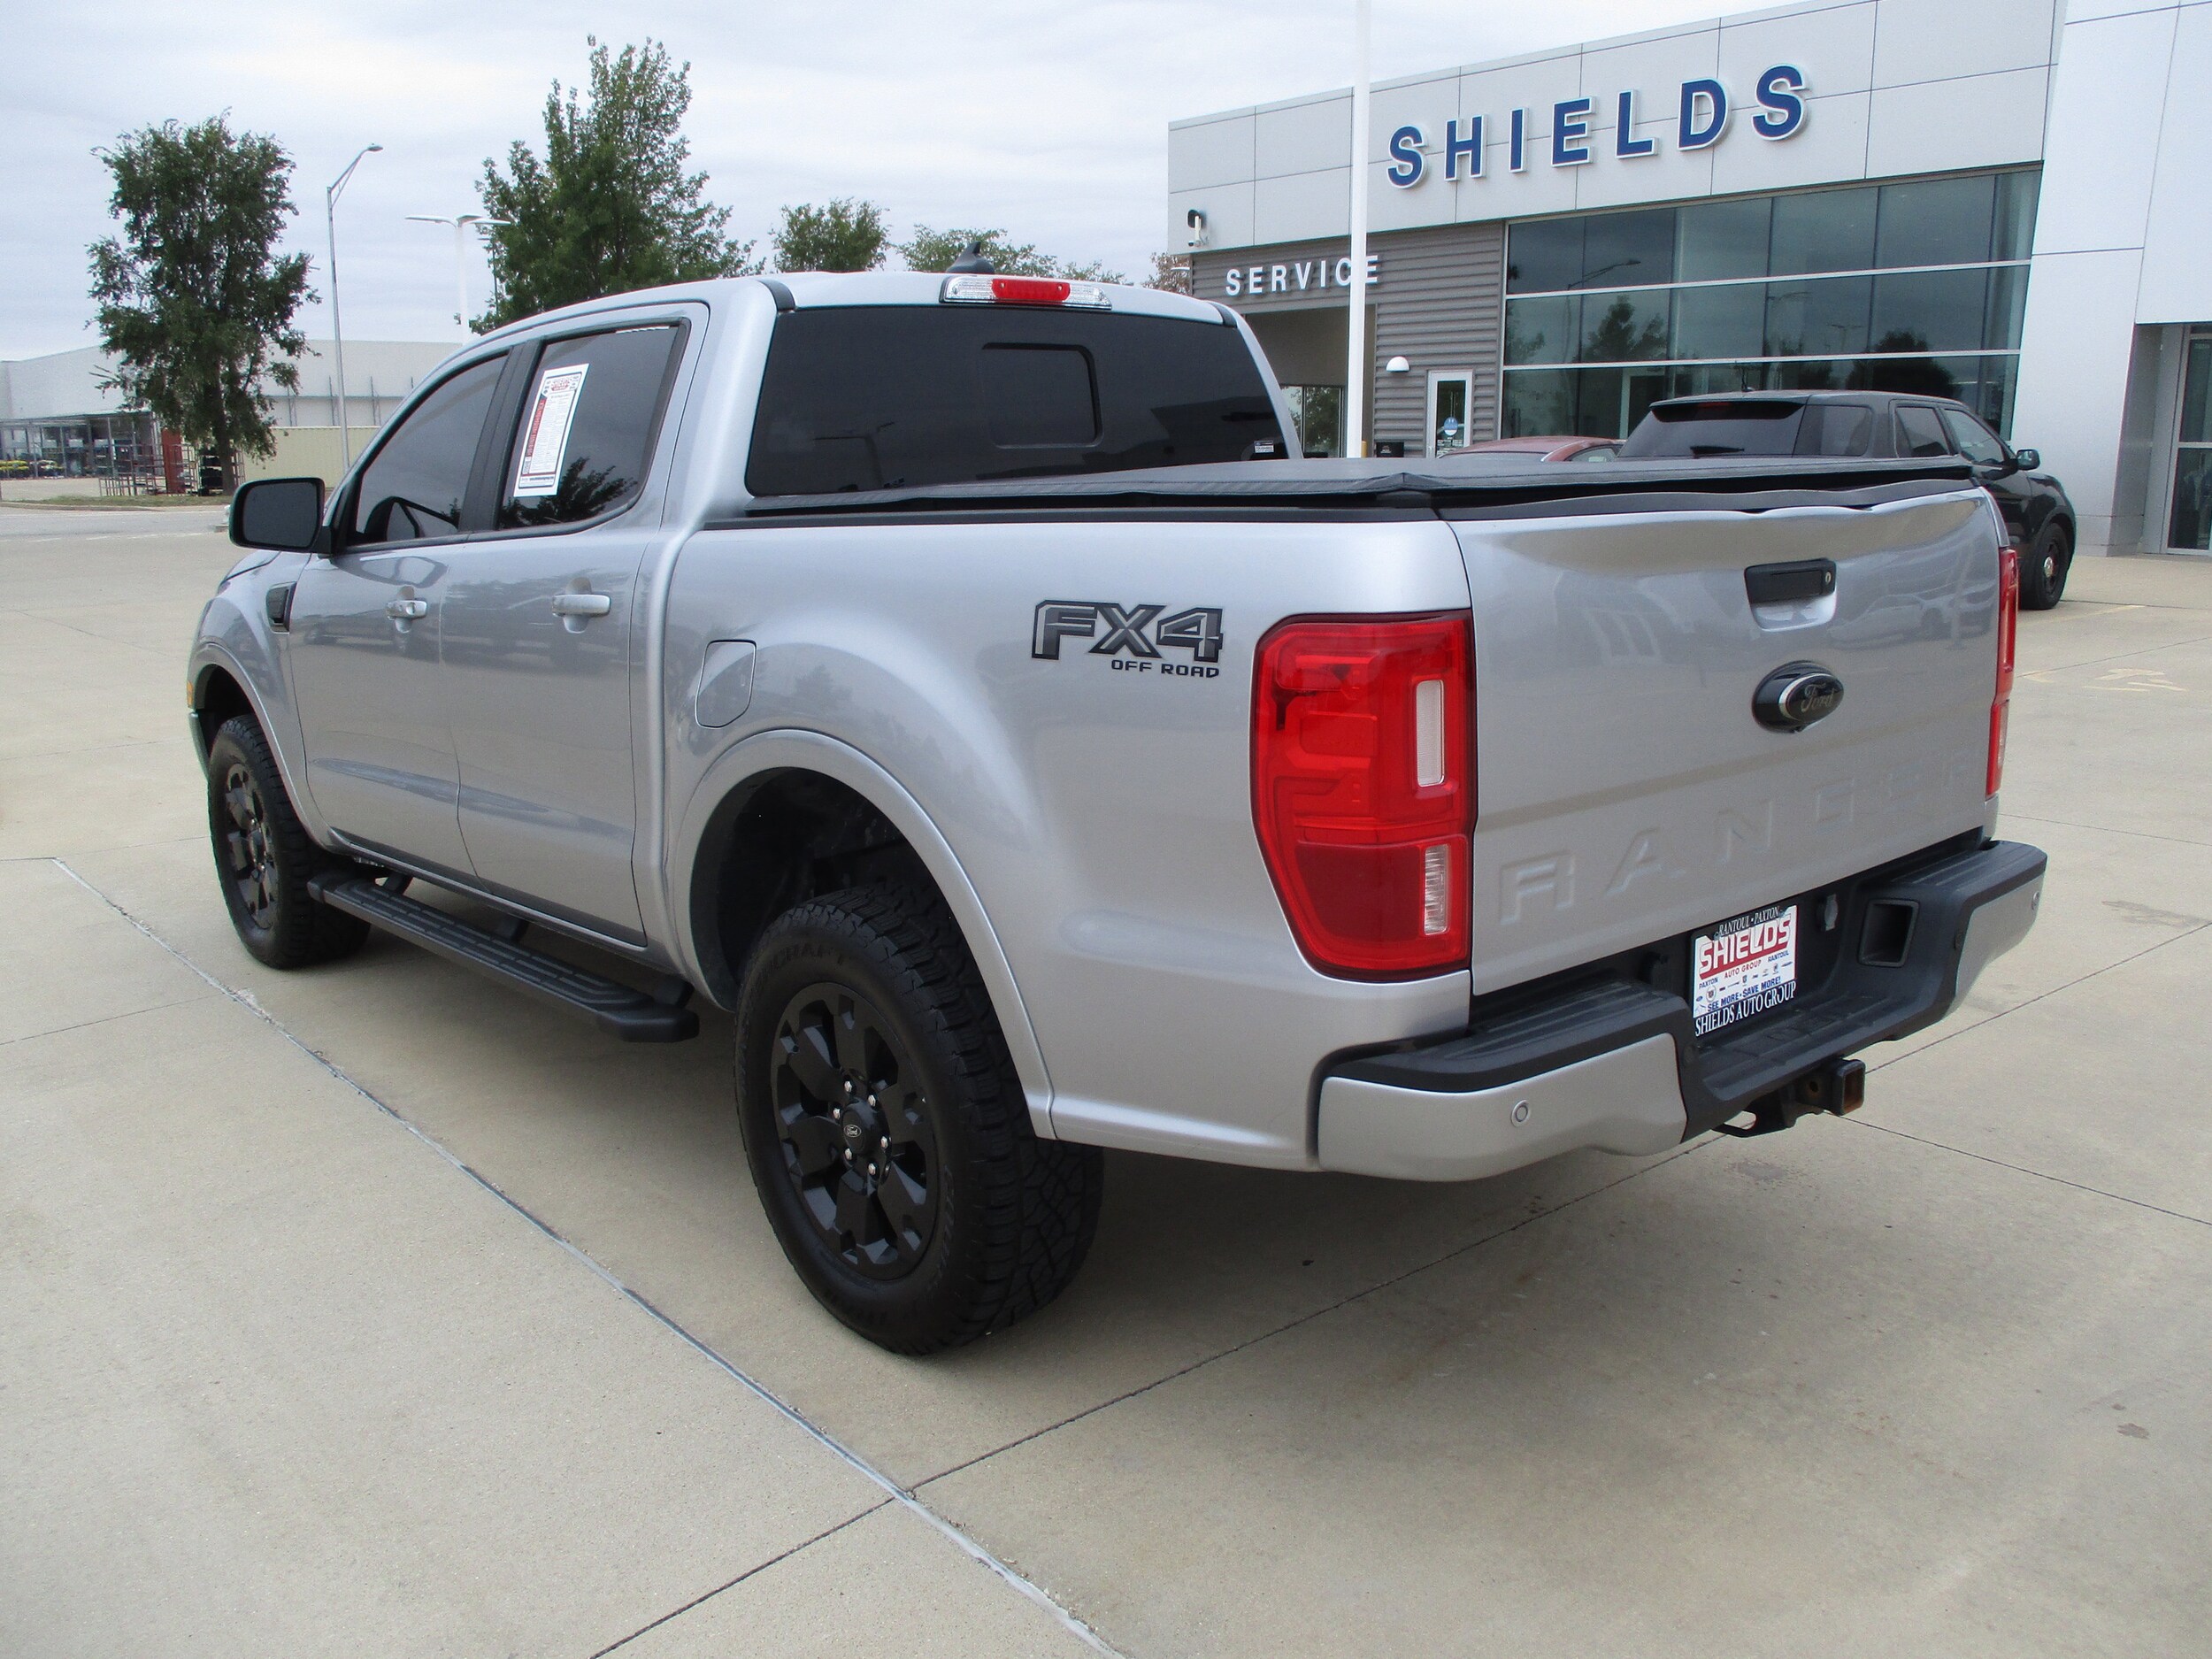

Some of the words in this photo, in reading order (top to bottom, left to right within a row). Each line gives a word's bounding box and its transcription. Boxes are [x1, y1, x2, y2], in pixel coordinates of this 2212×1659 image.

[1386, 64, 1809, 189] SHIELDS
[1225, 255, 1378, 296] SERVICE
[1031, 599, 1224, 663] FX4
[1110, 659, 1152, 672] OFF
[1161, 664, 1220, 678] ROAD
[1499, 757, 1970, 926] RANG
[1718, 918, 1751, 935] RANTOUL
[1754, 907, 1779, 925] PAXTON
[1699, 916, 1791, 973] SHIELDS
[1768, 950, 1789, 962] RANTOUL
[1699, 977, 1718, 989] PAXTON
[1724, 968, 1740, 979] AUTO
[1741, 960, 1762, 972] GROUP
[1695, 1005, 1735, 1037] SHIELDS
[1736, 996, 1764, 1020] AUTO
[1764, 980, 1796, 1008] GROUP
[1707, 1002, 1719, 1012] SEE
[1720, 992, 1740, 1006] MORE
[1742, 987, 1760, 997] SAVE
[1761, 976, 1781, 990] MORE!
